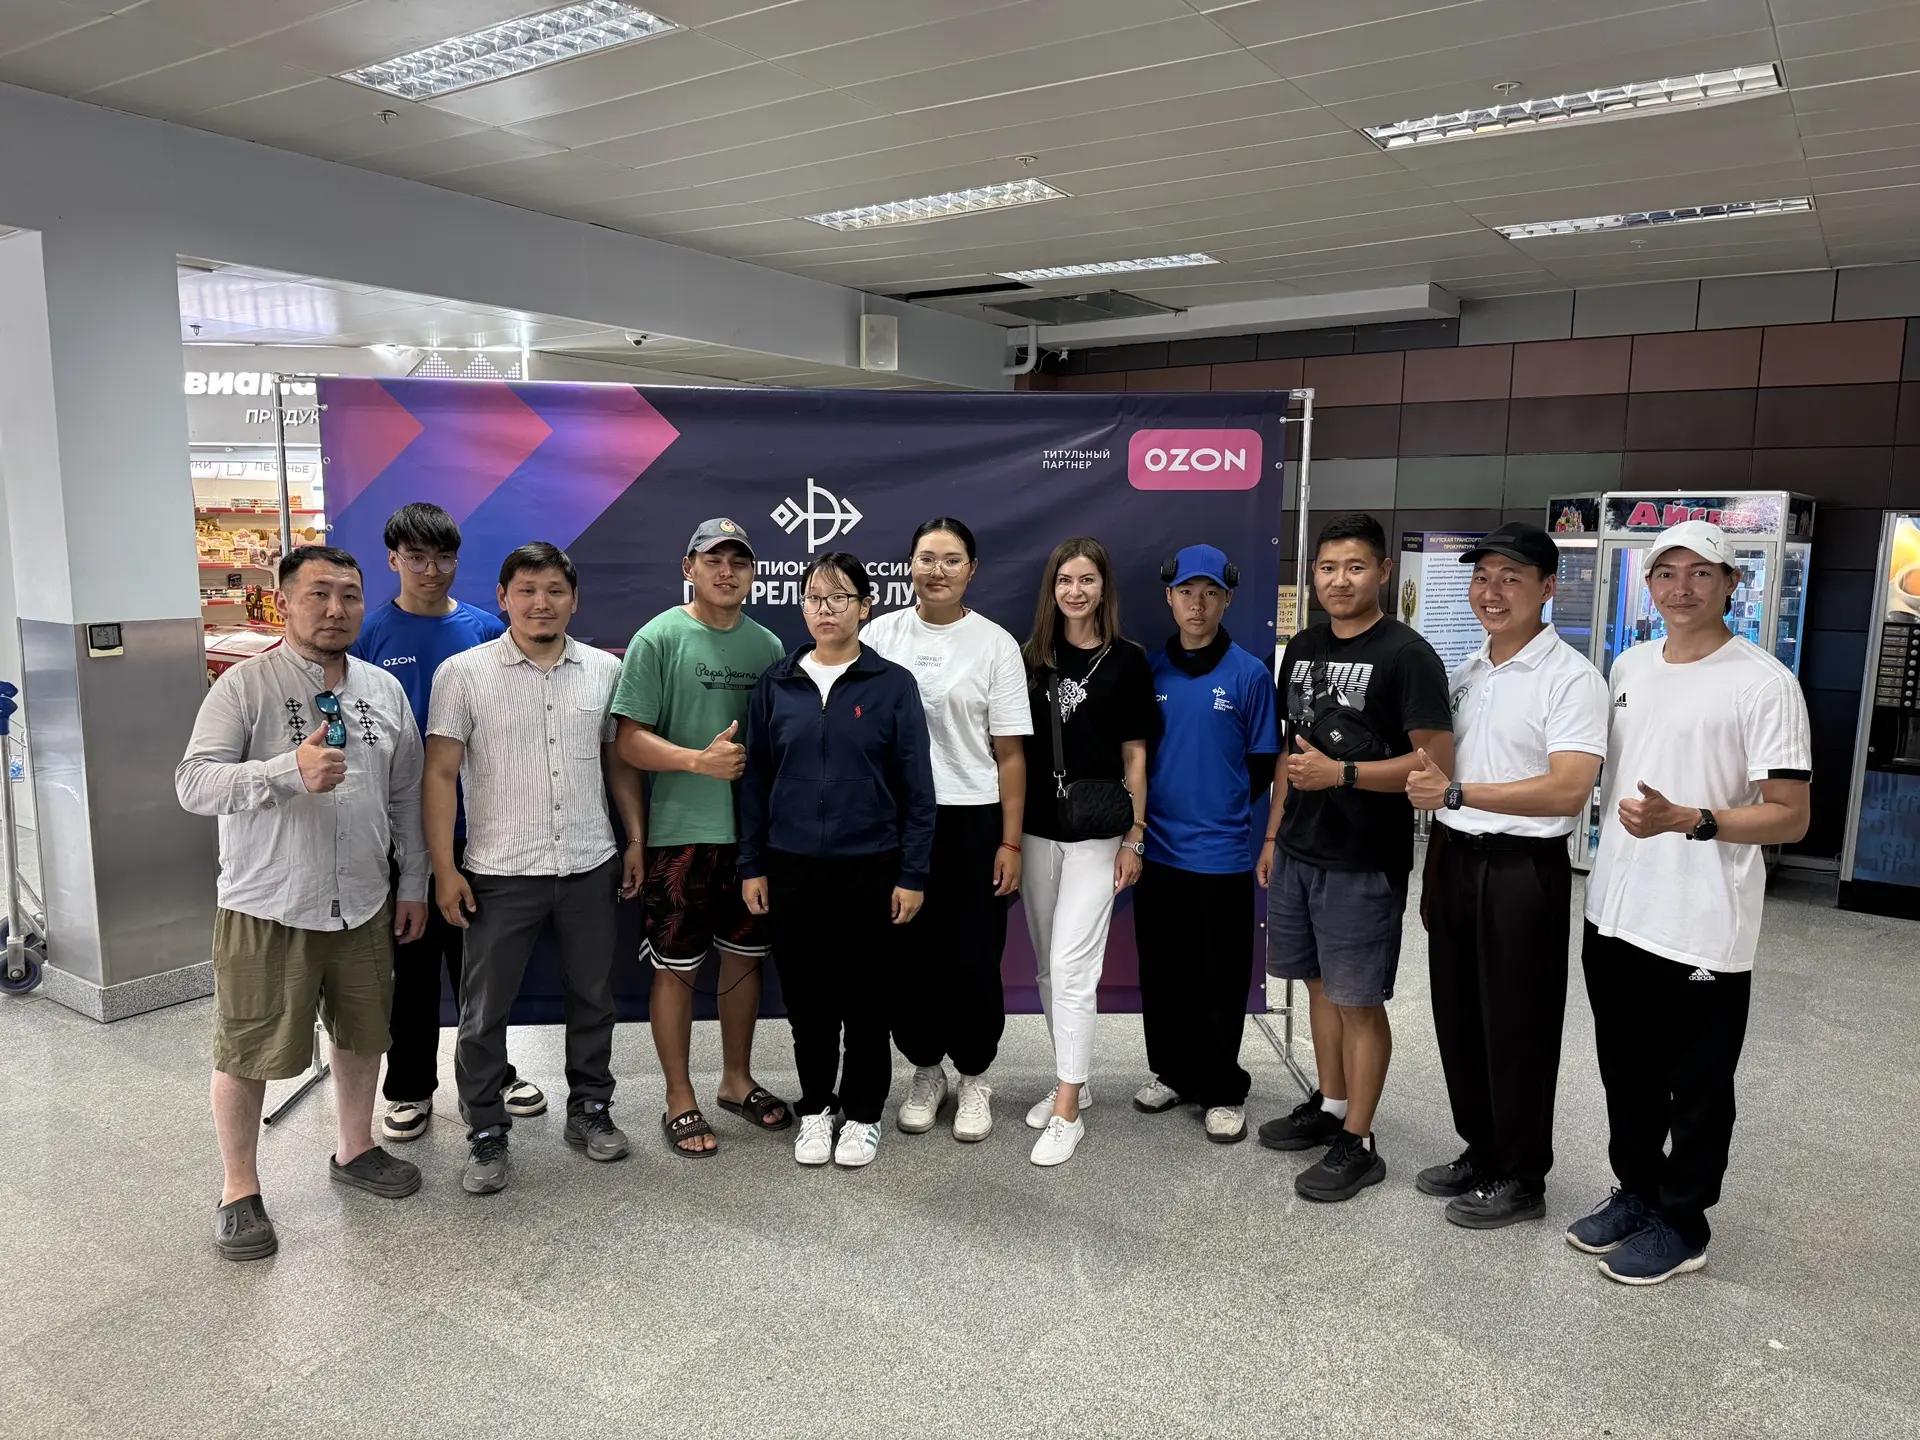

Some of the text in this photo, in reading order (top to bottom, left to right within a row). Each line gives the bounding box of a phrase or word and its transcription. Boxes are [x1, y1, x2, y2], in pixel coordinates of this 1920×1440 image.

[245, 409, 319, 426] ПРДУК
[1042, 449, 1111, 460] ТИТУЛЬНЫЙ
[1144, 448, 1246, 472] OZON
[254, 461, 310, 474] ПЕЧНЬЕ
[1042, 460, 1092, 469] ПАРТНЕР
[752, 560, 912, 577] ПИОН ССИИ
[741, 581, 804, 605] РЕЛ
[383, 656, 417, 667] OZON
[695, 662, 761, 684] Pepe Jeans
